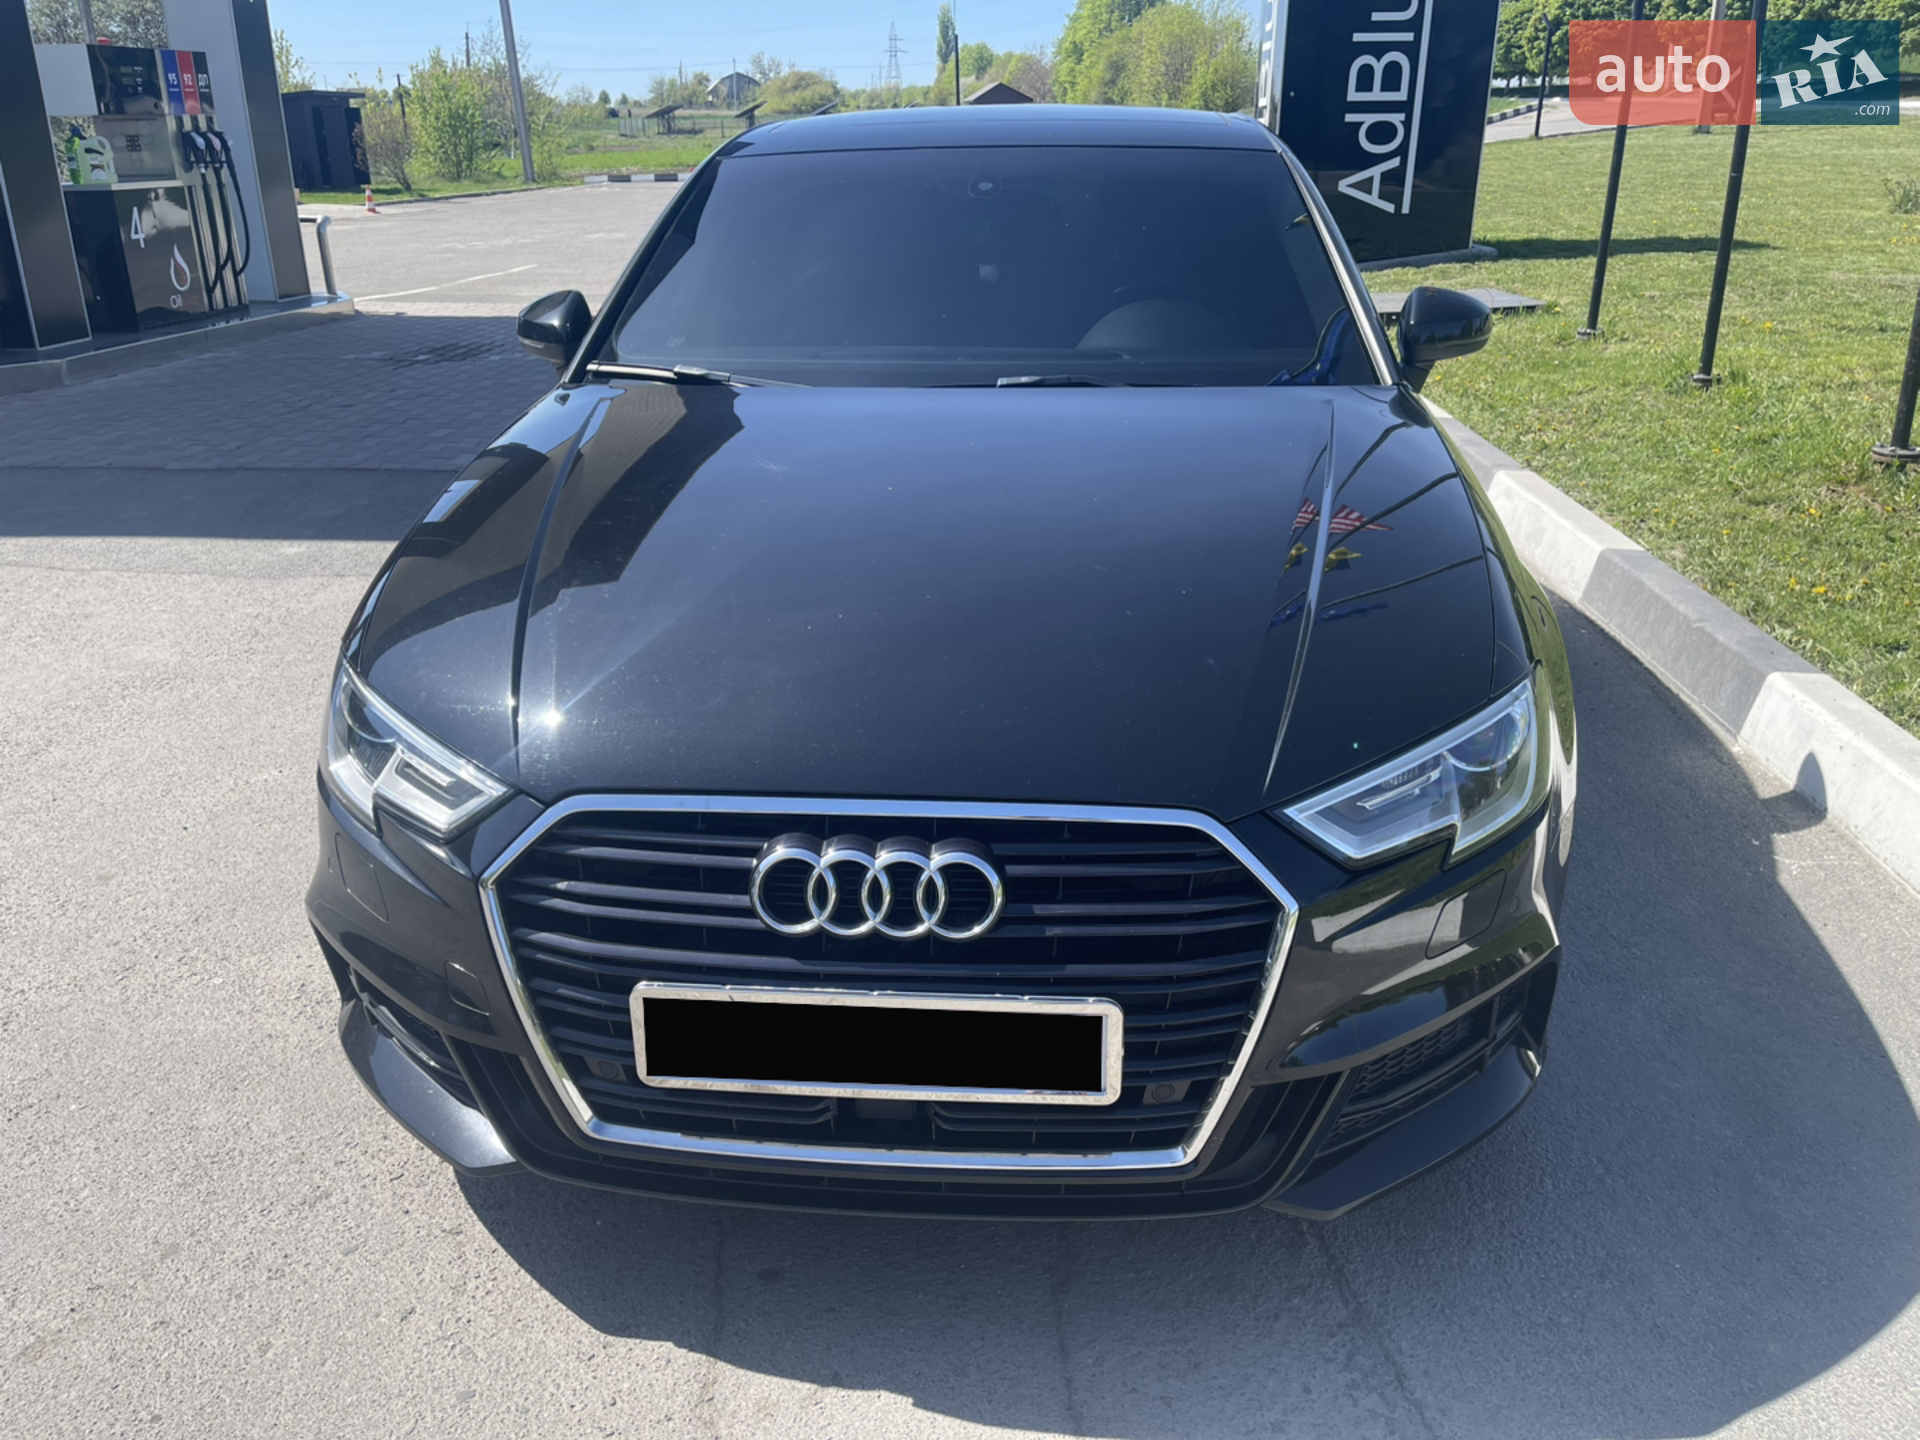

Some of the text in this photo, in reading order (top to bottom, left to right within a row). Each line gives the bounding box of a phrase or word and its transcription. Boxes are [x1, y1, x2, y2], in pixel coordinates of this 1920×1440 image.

[167, 72, 178, 85] 95
[183, 72, 193, 85] 92
[128, 206, 145, 249] 4
